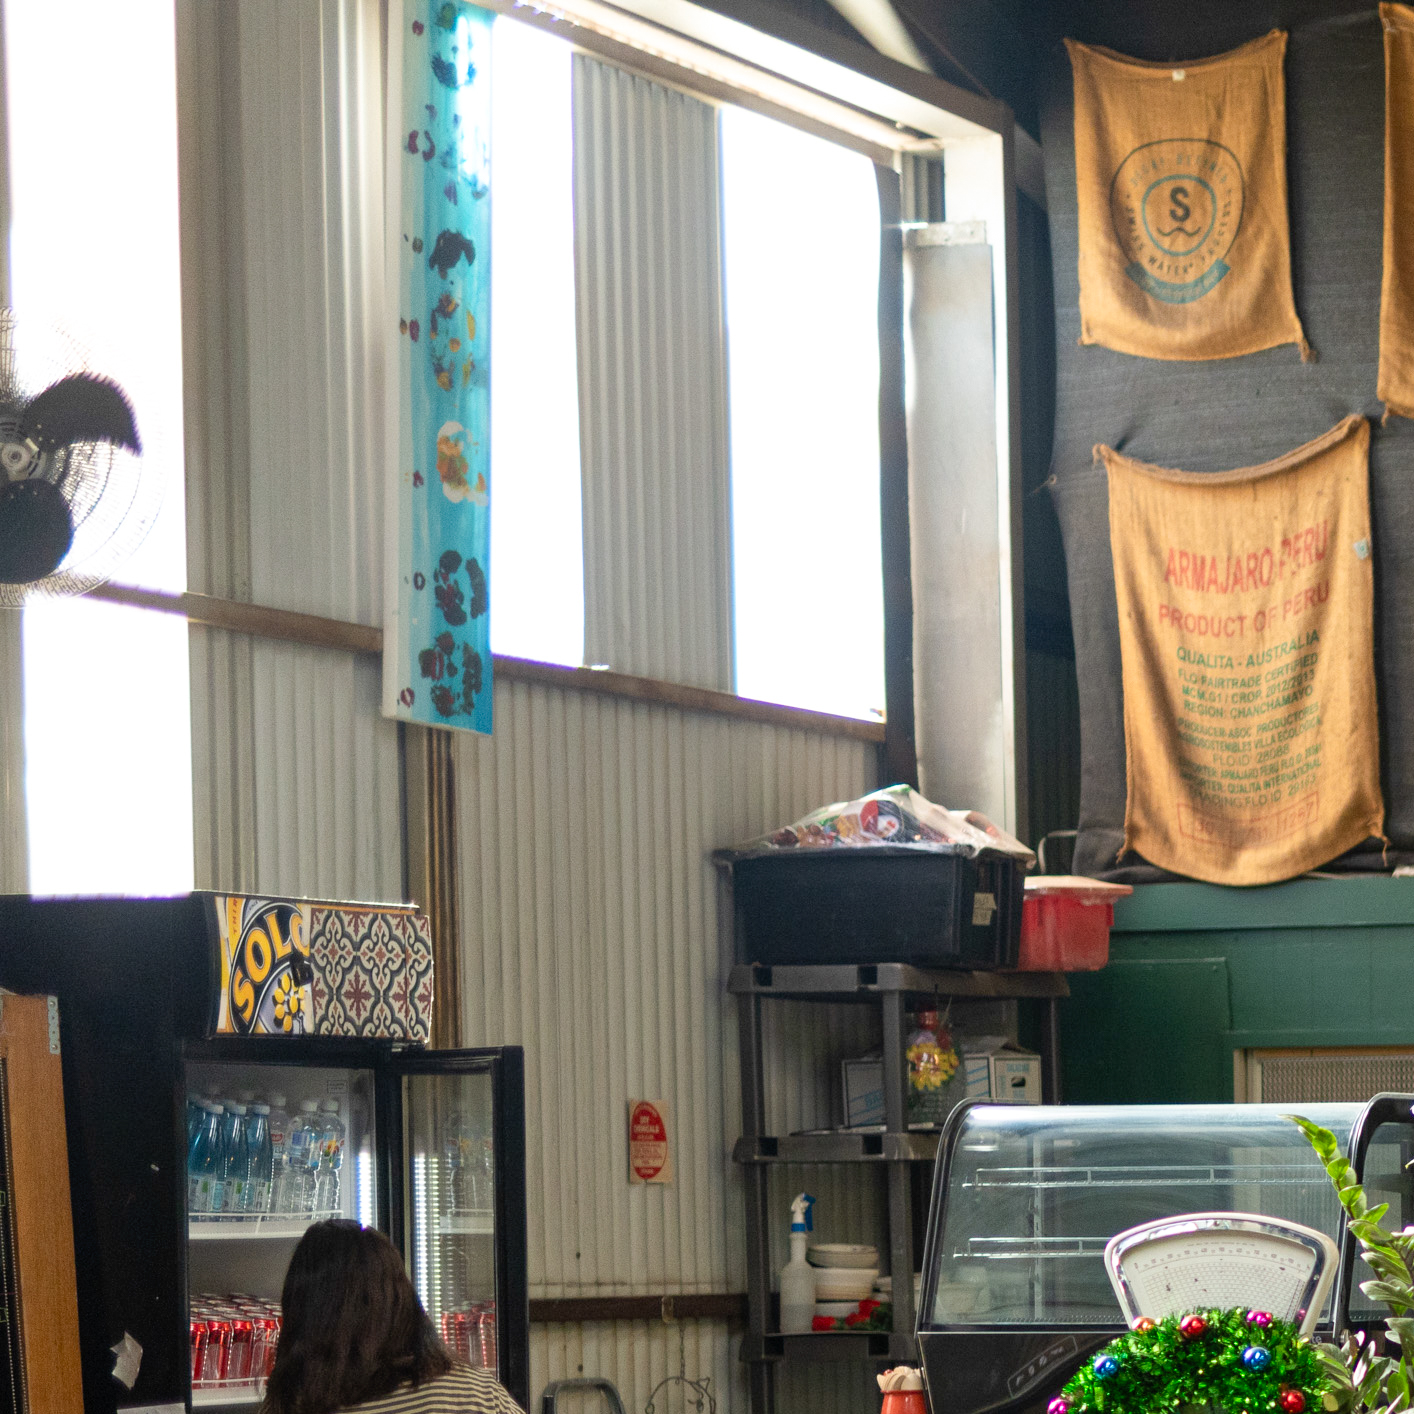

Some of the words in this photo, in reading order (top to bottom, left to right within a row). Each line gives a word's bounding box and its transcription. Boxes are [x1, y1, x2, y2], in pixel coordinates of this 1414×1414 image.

[1164, 547, 1274, 595] ARMAJARO
[1158, 603, 1248, 638] PRODUCT
[1253, 606, 1279, 633] OF
[1283, 580, 1330, 622] PERU
[1176, 646, 1234, 670] QUALITA
[1245, 628, 1320, 668] AUSTRALIA
